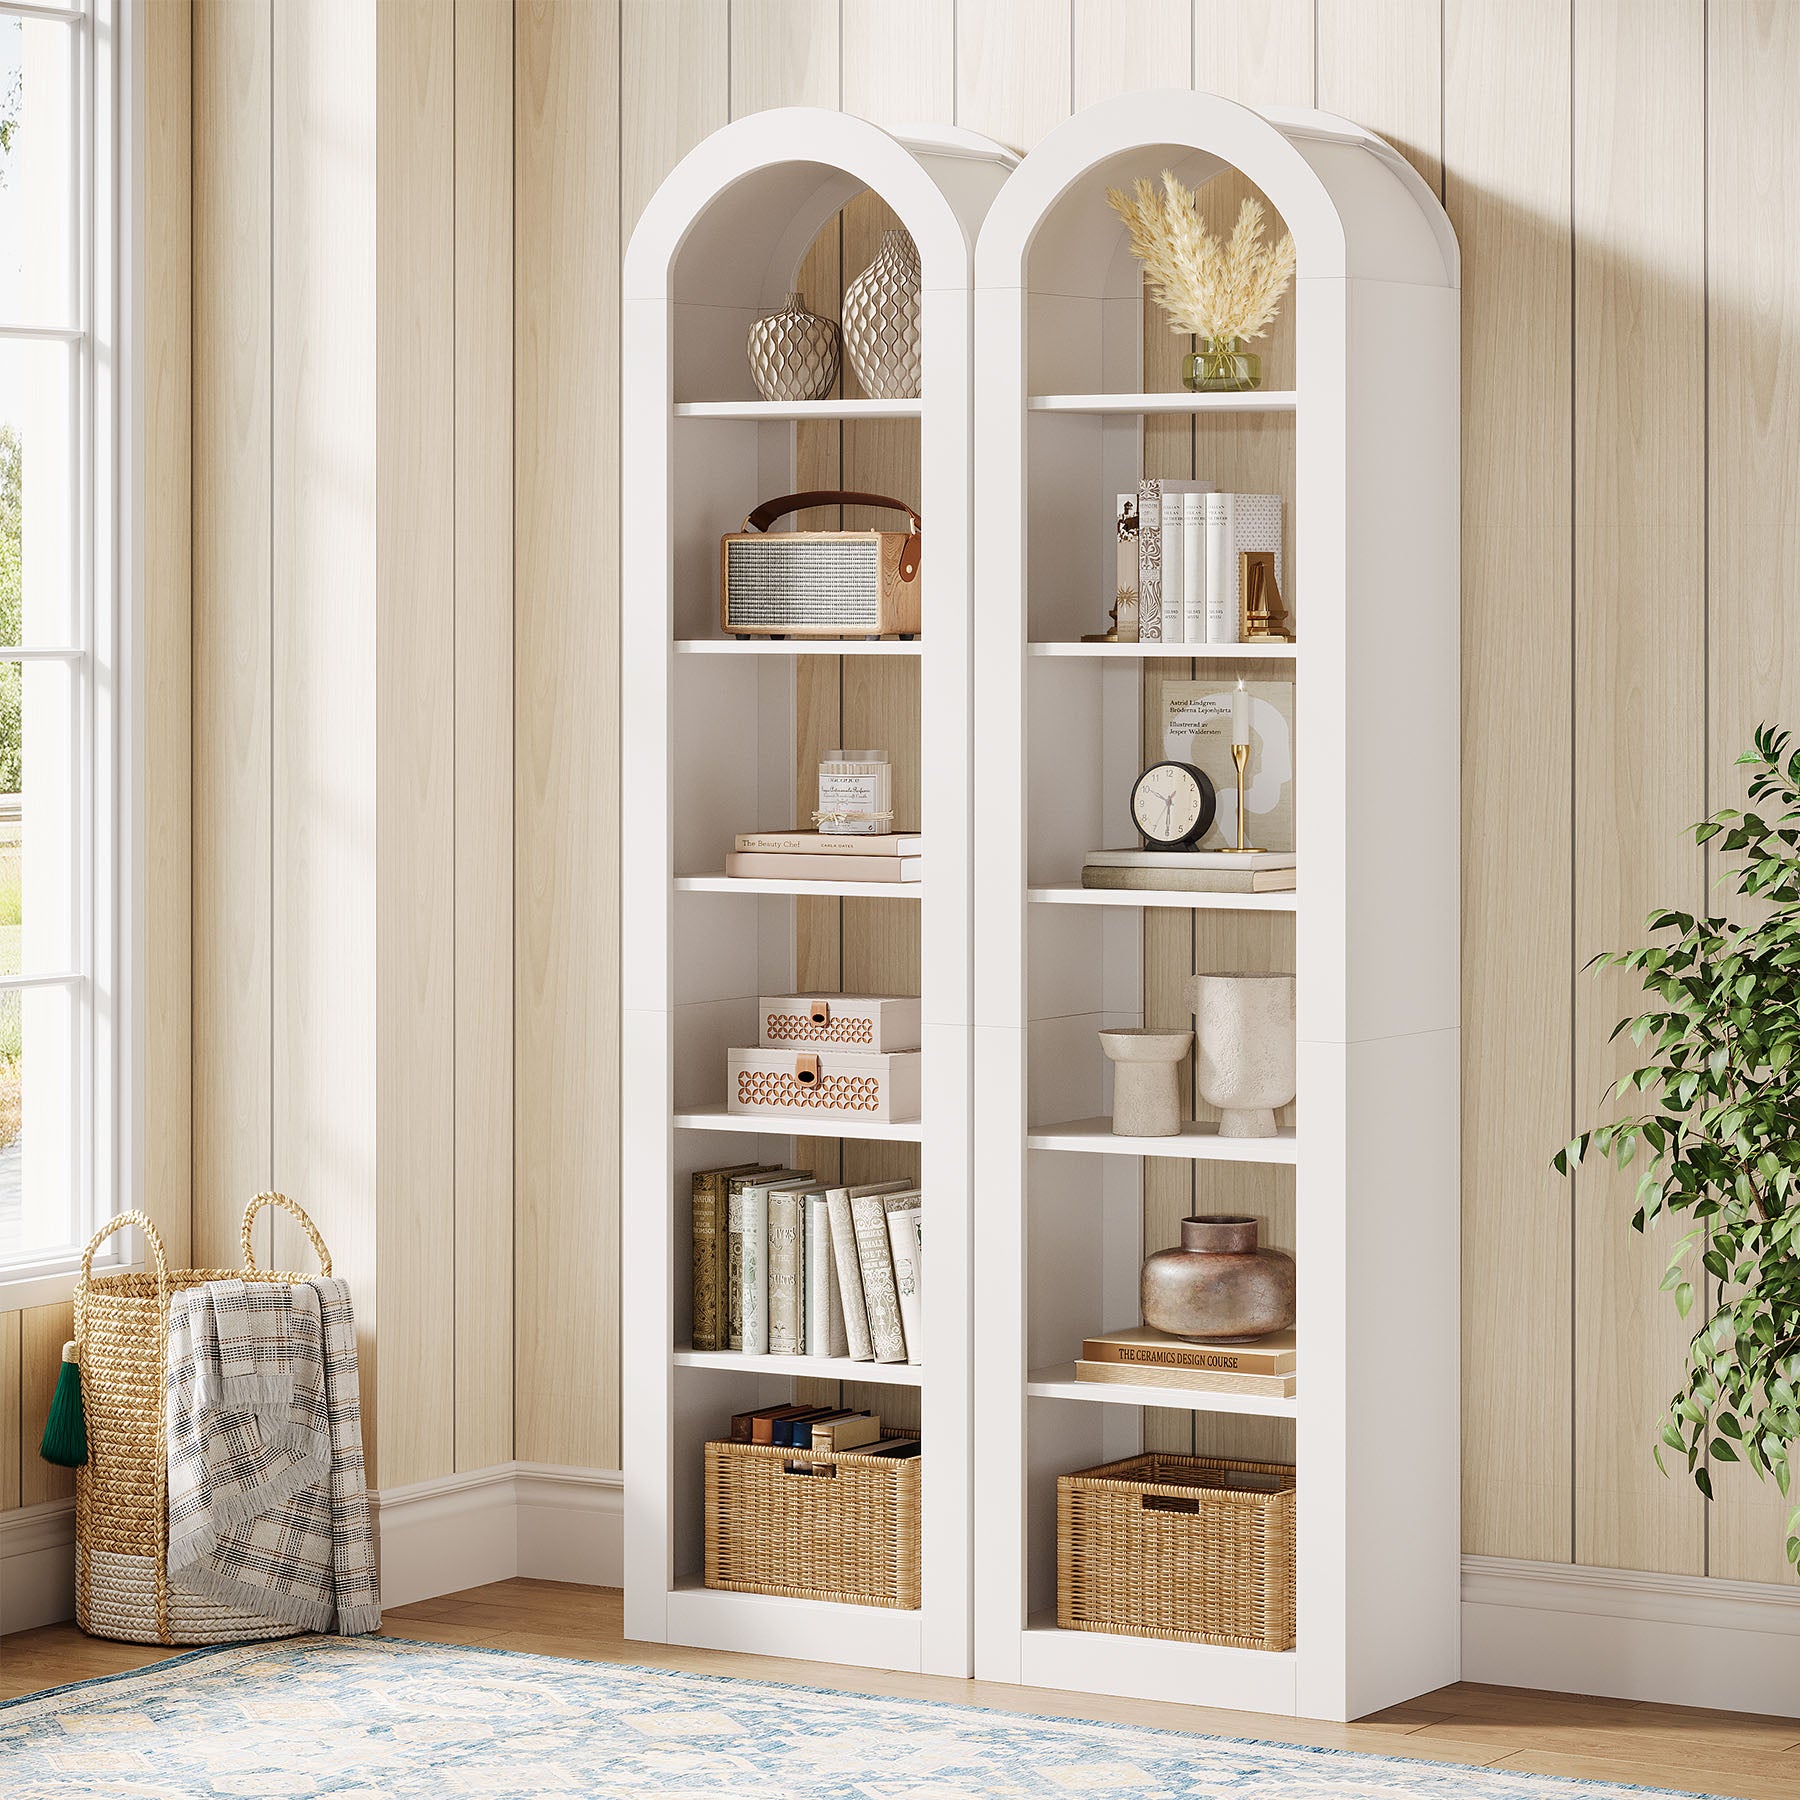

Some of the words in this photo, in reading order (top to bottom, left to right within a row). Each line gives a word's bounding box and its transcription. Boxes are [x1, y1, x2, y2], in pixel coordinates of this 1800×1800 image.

[1189, 699, 1217, 707] Lindgren
[1169, 728, 1187, 736] Jesper
[742, 839, 756, 847] The
[757, 840, 781, 849] Beauty
[783, 840, 800, 848] Chef
[861, 1248, 888, 1259] POETS
[1118, 1348, 1135, 1361] THE
[1136, 1349, 1176, 1364] CERAMICS
[1177, 1352, 1206, 1366] DESIGN
[1207, 1355, 1238, 1369] COURSE
